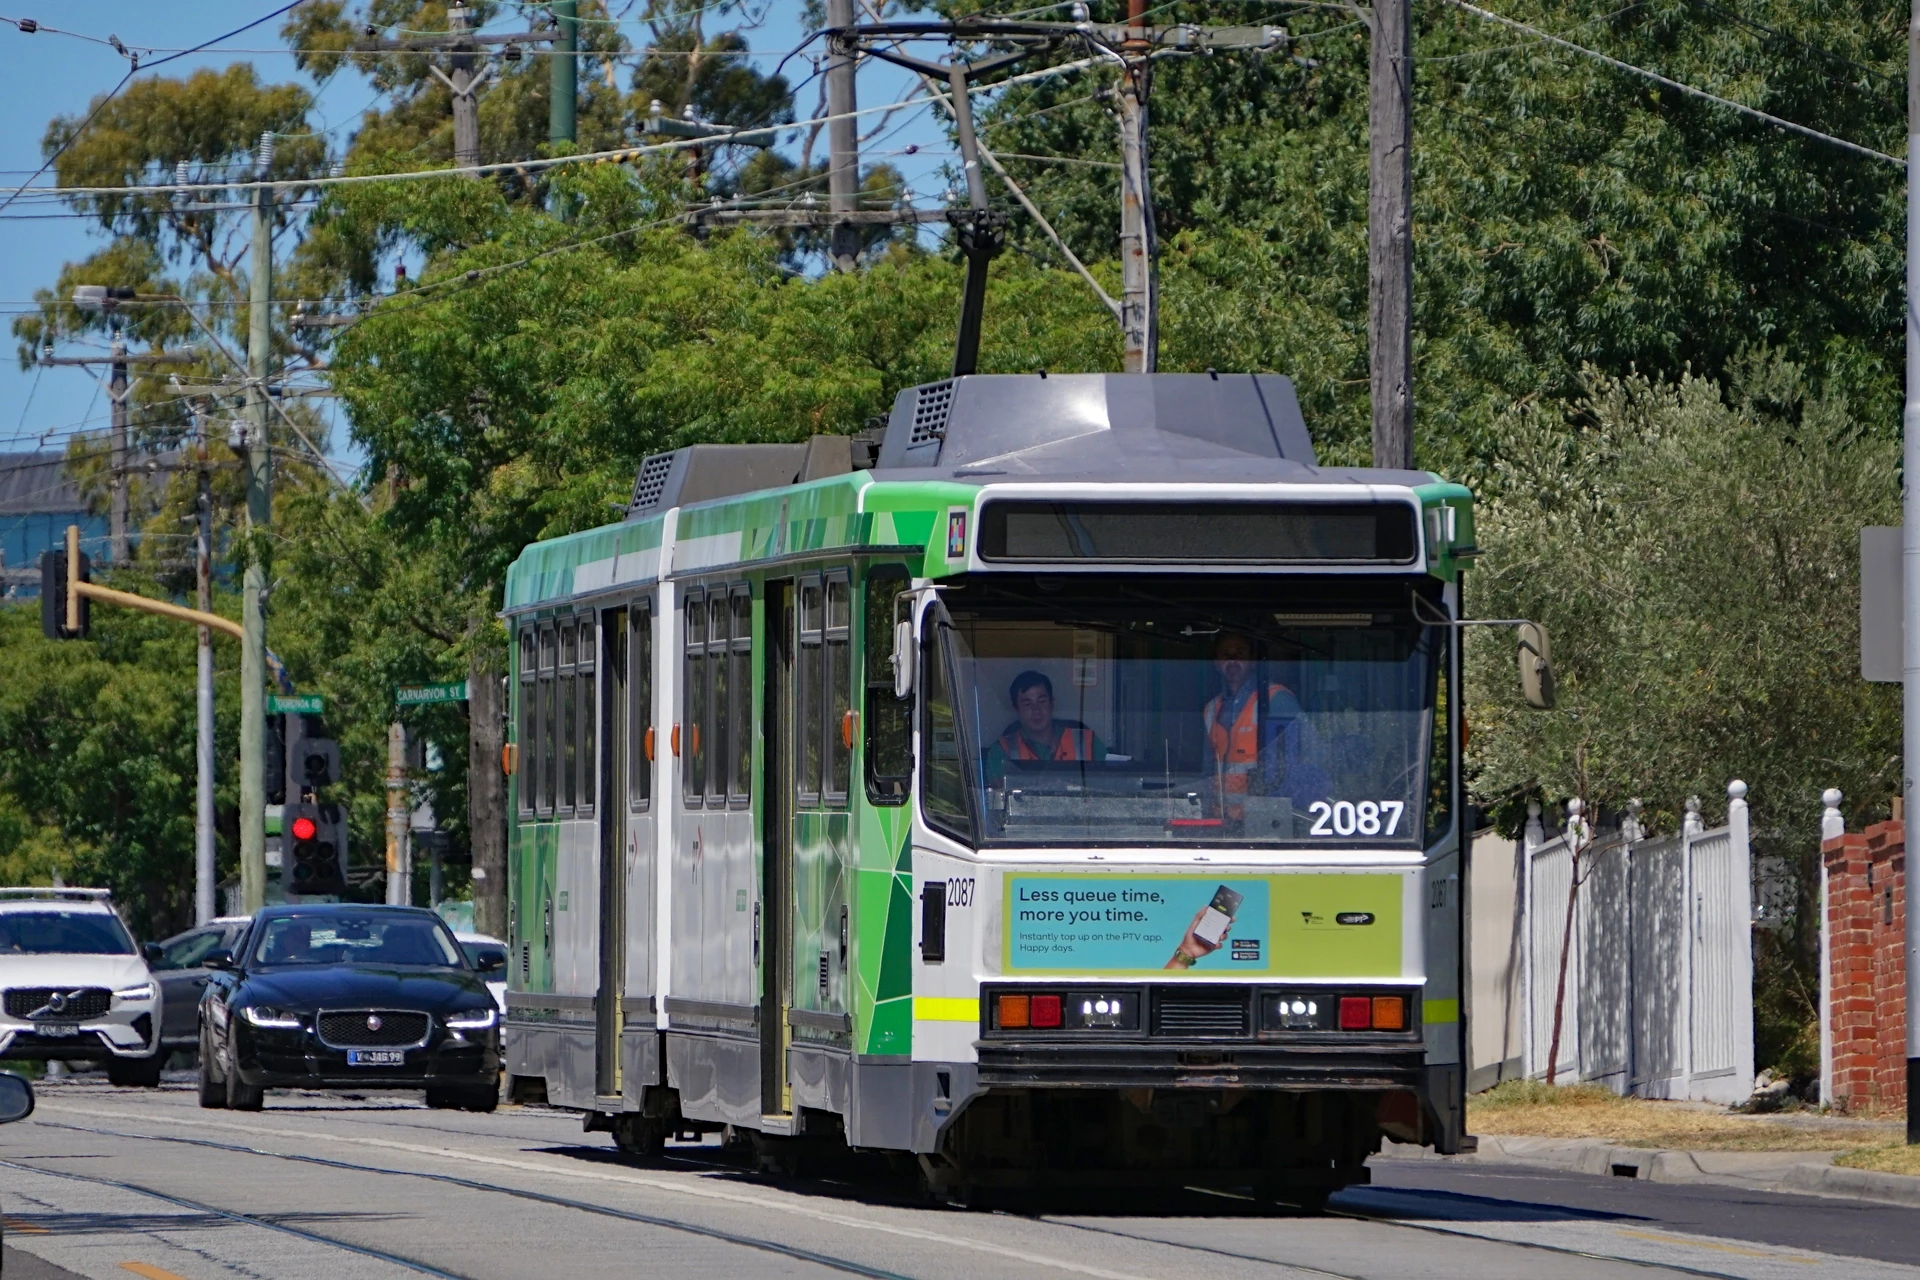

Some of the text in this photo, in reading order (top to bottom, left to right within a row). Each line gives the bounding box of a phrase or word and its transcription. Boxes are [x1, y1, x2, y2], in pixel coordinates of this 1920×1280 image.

[397, 686, 460, 701] CARNARVON ST
[1309, 801, 1404, 836] 2087
[948, 877, 975, 907] 2087
[1020, 887, 1165, 905] Less queue time,
[1020, 908, 1148, 925] more you time.
[1019, 932, 1059, 943] Instantly
[1060, 934, 1076, 943] top
[1078, 934, 1090, 943] up
[1105, 932, 1121, 941] the
[1122, 933, 1142, 941] PTV
[1143, 935, 1164, 943] app.
[1019, 944, 1076, 953] Happy days.
